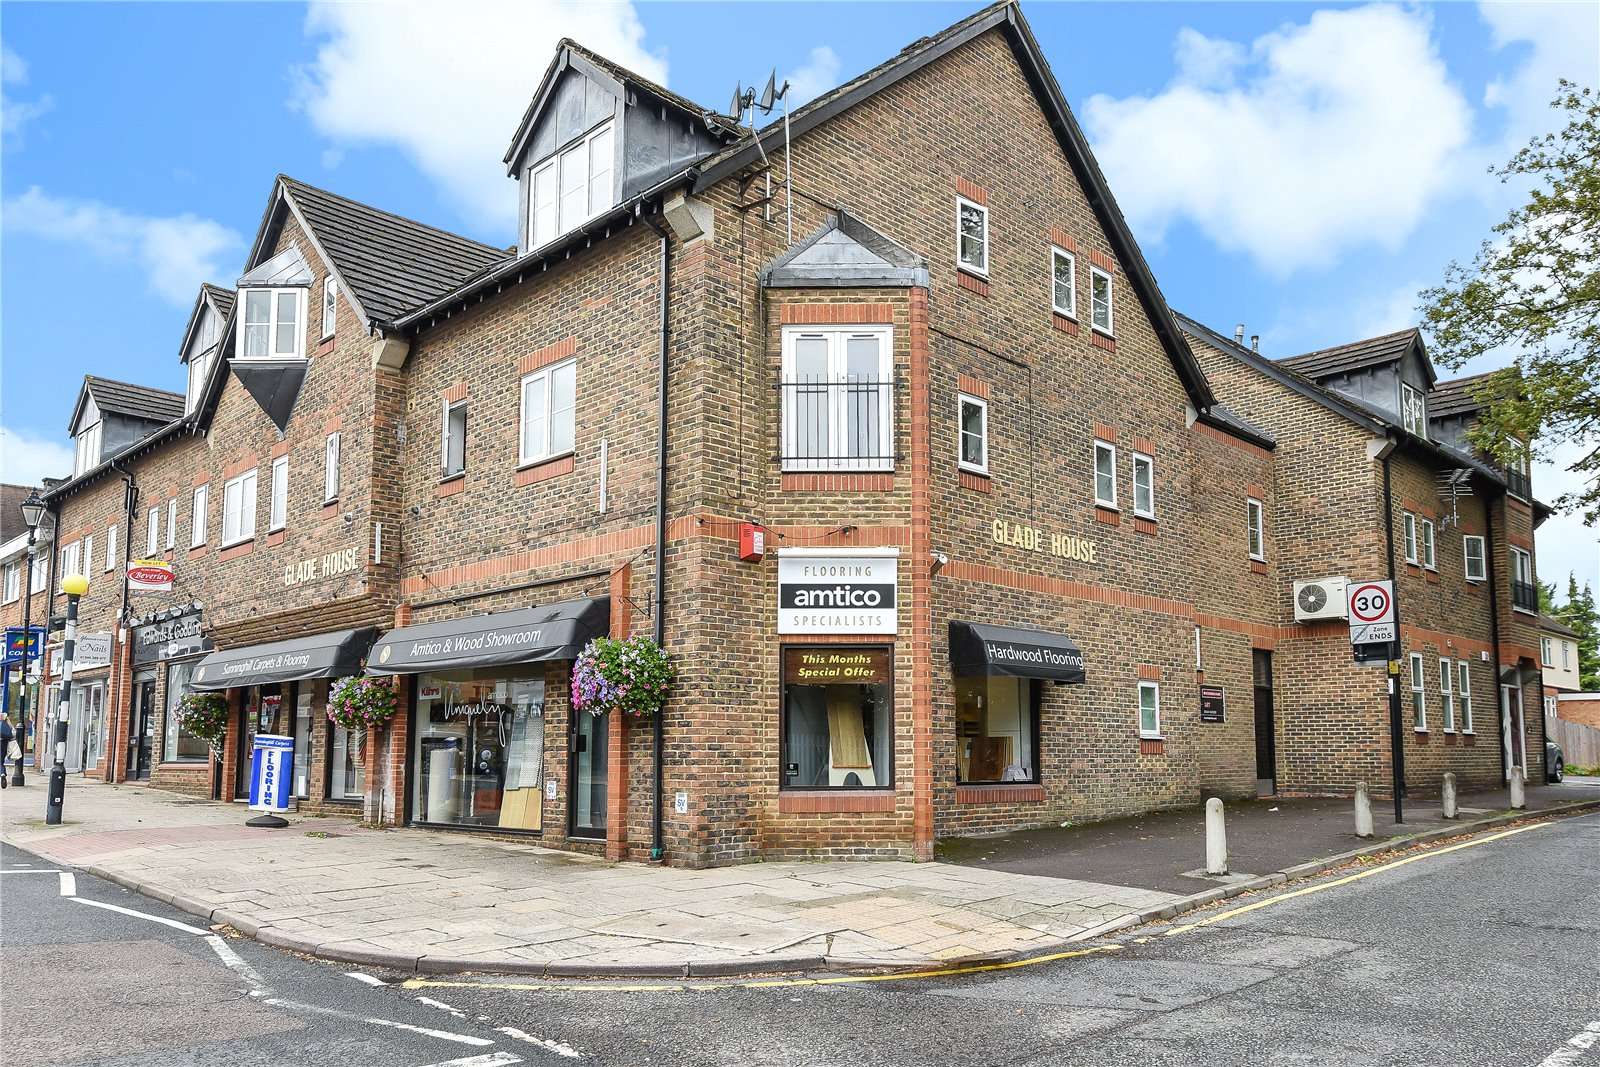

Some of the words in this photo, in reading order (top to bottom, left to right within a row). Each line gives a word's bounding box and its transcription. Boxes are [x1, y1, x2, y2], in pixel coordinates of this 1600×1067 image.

[992, 519, 1042, 552] GLADE
[1051, 533, 1097, 563] HOUSE
[285, 558, 317, 585] GLADE
[322, 546, 359, 577] HOUSE
[804, 566, 872, 577] FLOORING
[793, 585, 881, 606] amtico
[1357, 595, 1385, 611] 30
[793, 615, 882, 626] SPECIALISTS
[410, 642, 441, 657] Amtico
[443, 638, 452, 652] &
[454, 634, 485, 651] Wood
[485, 629, 541, 648] Showroom
[1369, 632, 1393, 640] ENDS
[253, 658, 275, 672] Carpets
[275, 656, 282, 667] &
[283, 653, 310, 667] Flooring
[802, 654, 826, 664] This
[828, 654, 872, 664] Months
[987, 643, 1043, 663] Hardwood
[1043, 649, 1084, 670] Flooring
[798, 667, 841, 678] Special
[844, 667, 875, 677] Offer
[264, 750, 275, 806] FLOORING
